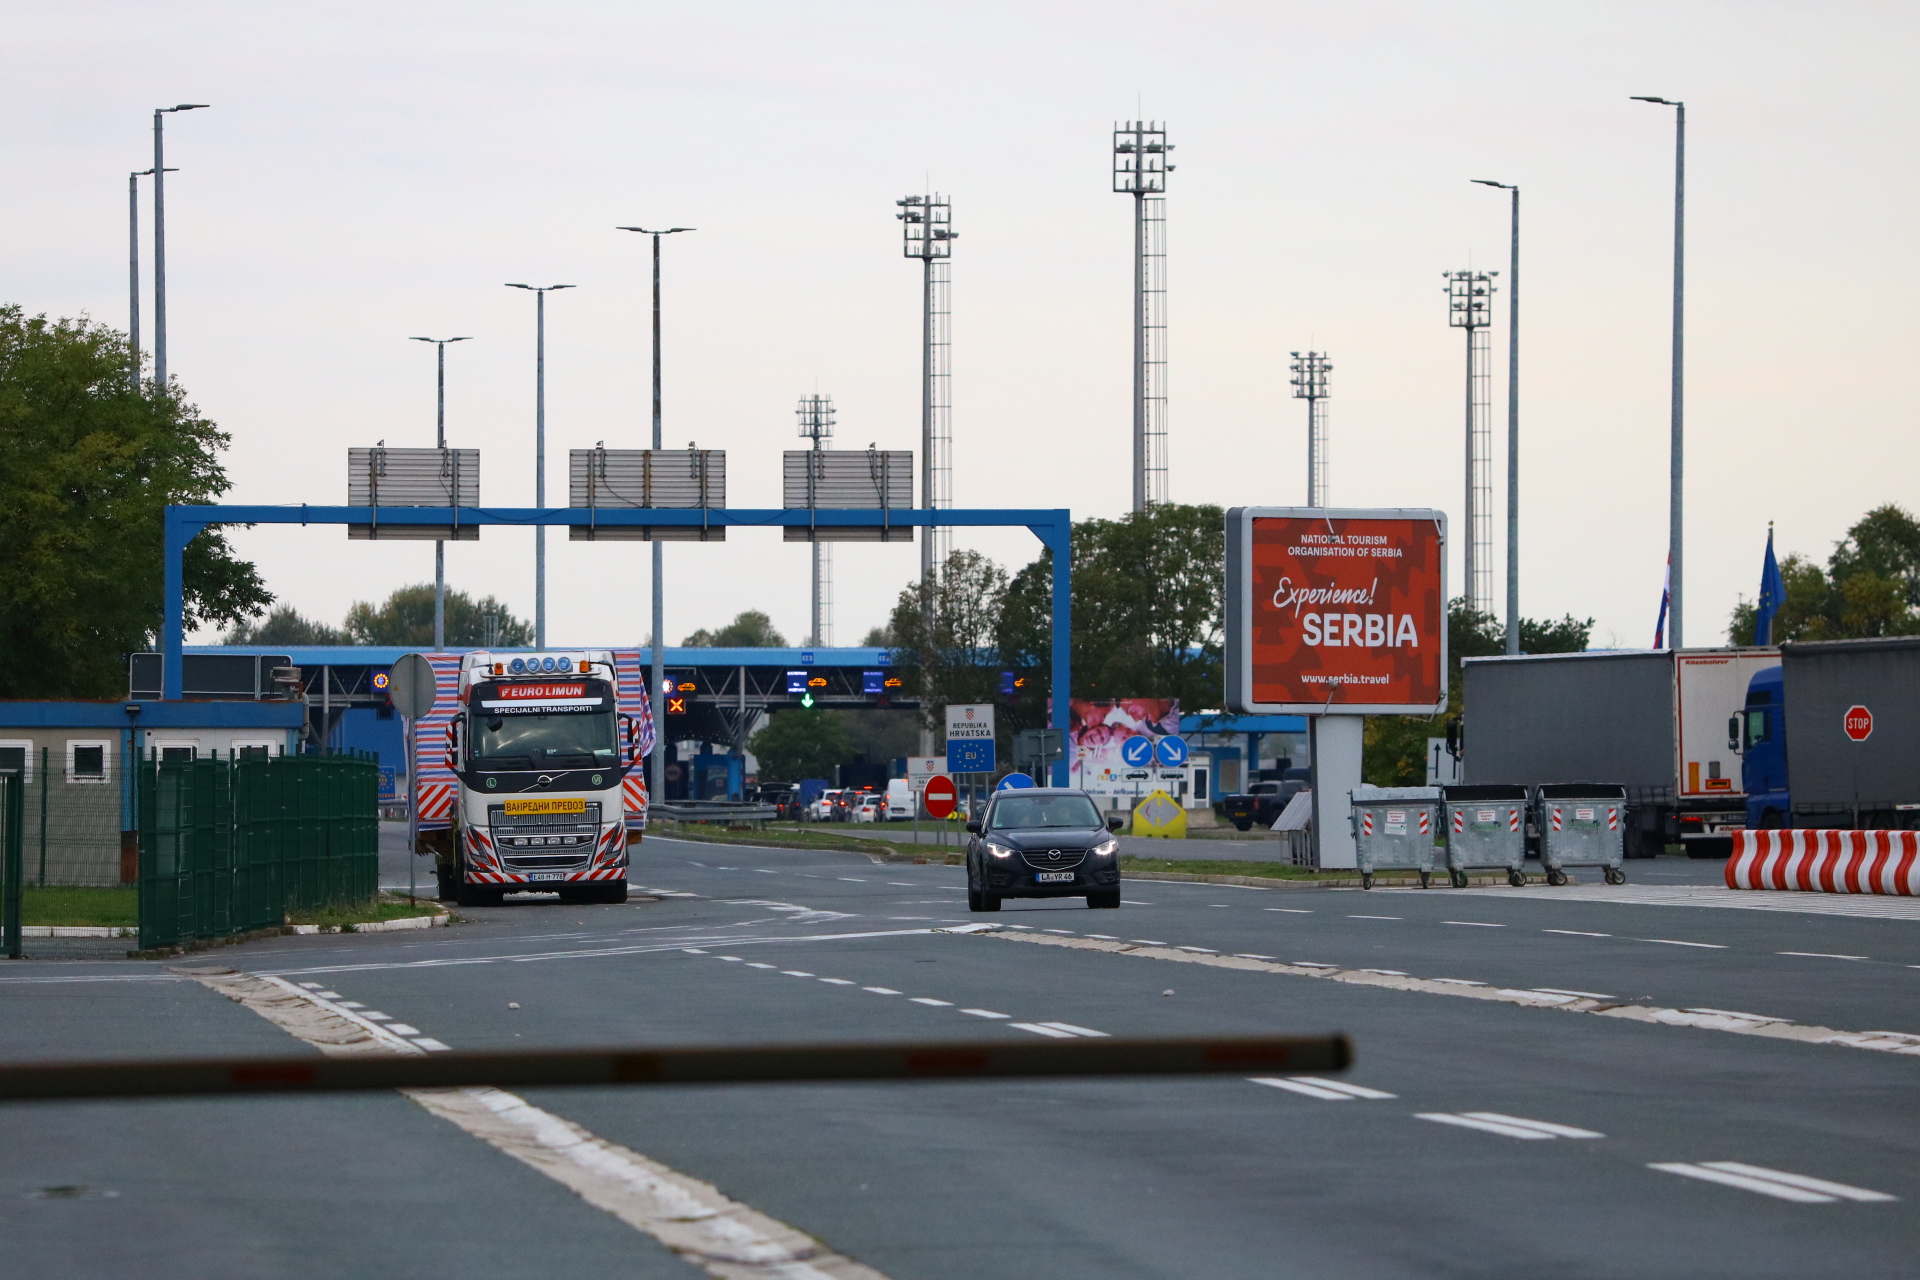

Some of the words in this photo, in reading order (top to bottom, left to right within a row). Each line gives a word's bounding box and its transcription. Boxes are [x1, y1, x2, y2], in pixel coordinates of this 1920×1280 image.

[1347, 535, 1387, 545] TOURISM
[1287, 546, 1355, 557] ORGANISATION
[1356, 547, 1370, 557] OF
[1371, 548, 1403, 558] SERBIA
[1273, 576, 1378, 619] Experience!
[1302, 612, 1419, 648] SERBIA
[1301, 674, 1390, 684] www.serbia.travel
[511, 687, 543, 697] EURO
[545, 686, 582, 696] LIMUN
[541, 705, 592, 713] TRANSPORTI
[1848, 717, 1869, 729] STOP
[949, 729, 991, 737] HRVATSKA
[965, 751, 977, 760] EU
[506, 803, 550, 812] ВАНРЕДНИ
[551, 801, 584, 811] ПРЕВОЗ
